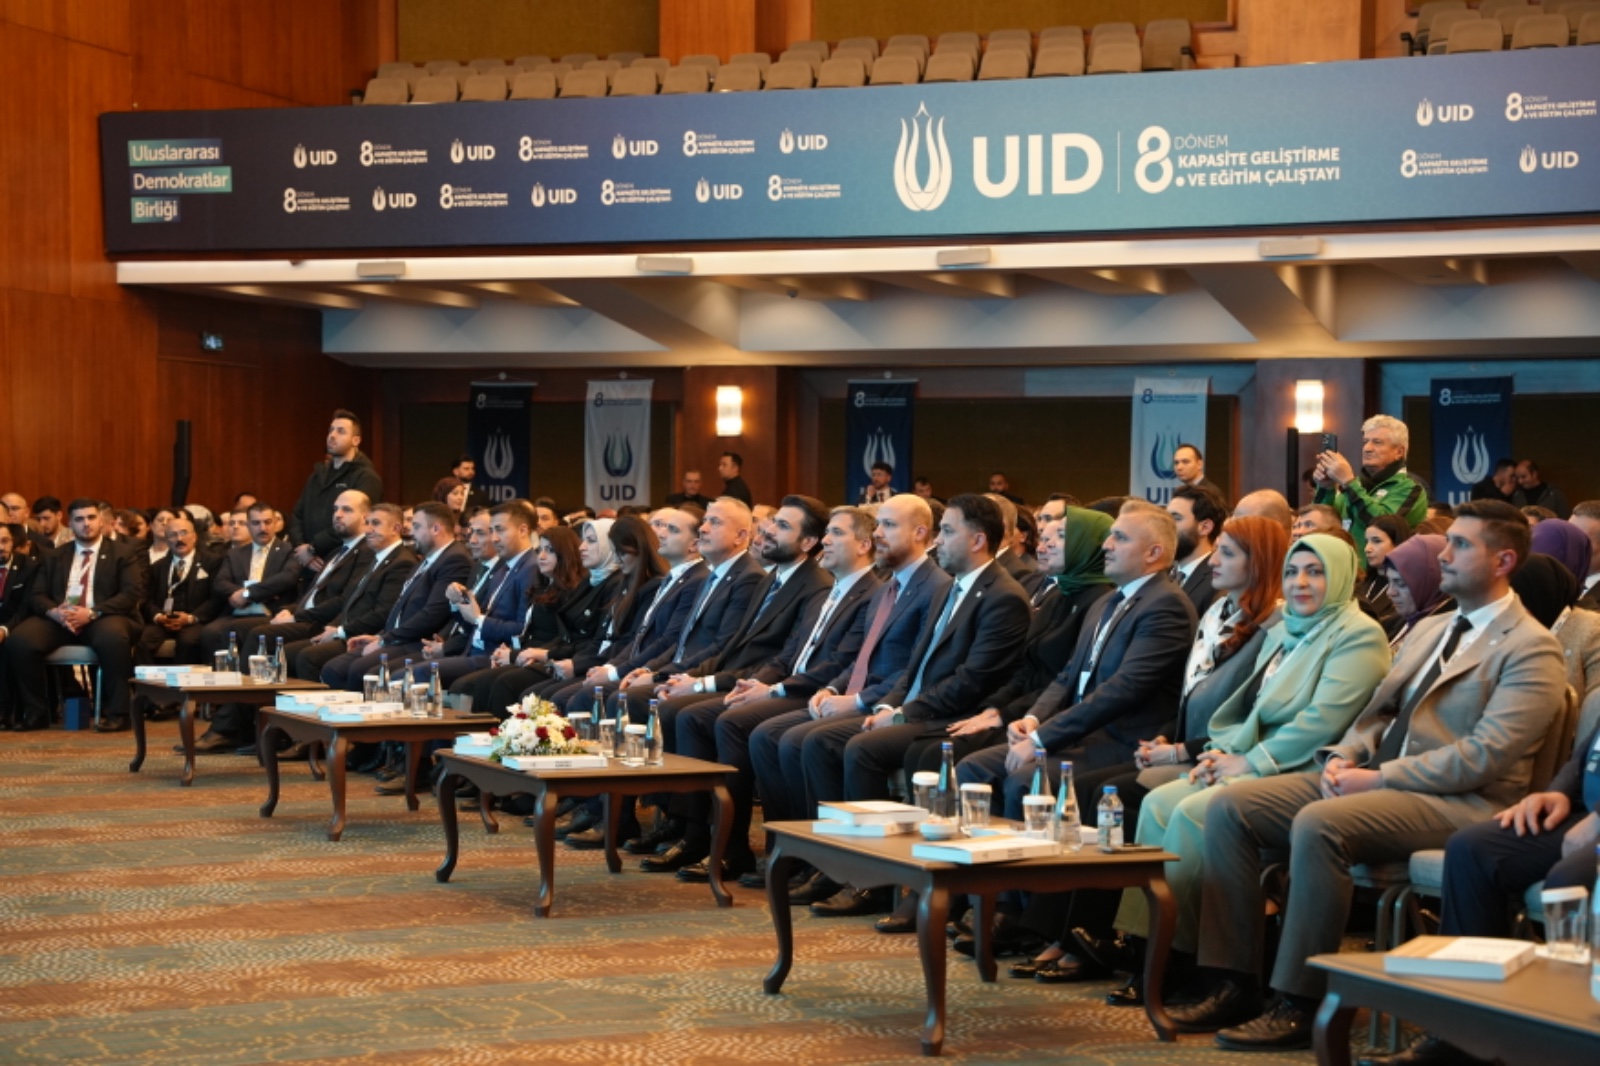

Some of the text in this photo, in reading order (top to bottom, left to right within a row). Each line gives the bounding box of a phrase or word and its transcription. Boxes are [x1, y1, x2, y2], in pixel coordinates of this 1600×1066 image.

[1438, 105, 1474, 122] UID
[629, 140, 659, 156] UID
[798, 135, 828, 150] UID
[1174, 134, 1228, 150] DÖNEM
[132, 144, 220, 161] Uluslararası
[309, 150, 337, 165] UID
[467, 145, 496, 160] UID
[1178, 147, 1340, 168] KAPASİTE GELİŞTİRME
[1541, 151, 1579, 169] UID
[973, 133, 1103, 198] UID
[133, 172, 228, 190] Demokratlar
[1187, 166, 1340, 186] VE EĞİTİM ÇALIŞTAYI
[548, 188, 577, 204] UID
[713, 184, 742, 199] UID
[388, 193, 417, 208] UID
[135, 200, 178, 221] Birliği
[601, 485, 636, 501] UID
